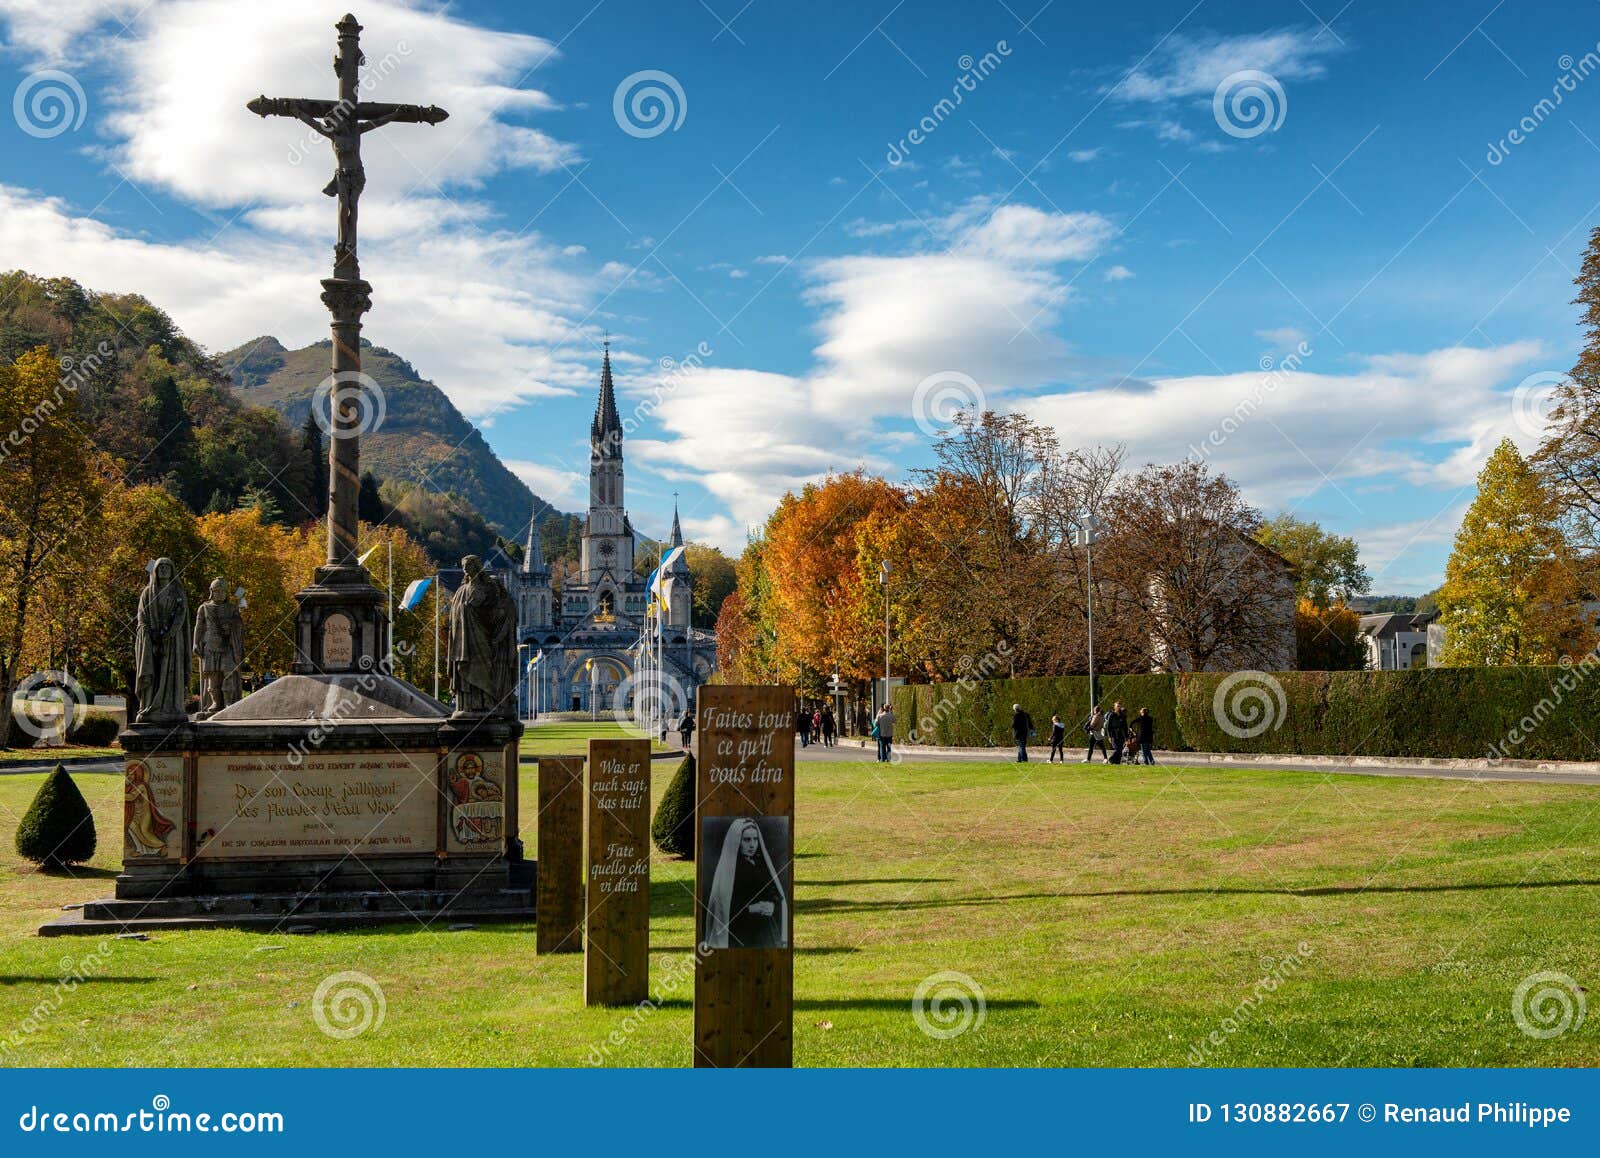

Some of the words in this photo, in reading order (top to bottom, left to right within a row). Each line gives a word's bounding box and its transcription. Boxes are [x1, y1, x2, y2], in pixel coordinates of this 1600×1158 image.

[702, 705, 752, 731] Faites
[758, 708, 793, 729] tout
[717, 738, 733, 756] ce
[738, 731, 772, 764] qu'il
[600, 759, 625, 774] Was
[628, 763, 640, 774] er
[709, 765, 745, 784] vous
[750, 758, 783, 784] dira
[235, 784, 256, 799] De
[264, 786, 287, 798] son
[592, 776, 617, 792] euch
[621, 778, 648, 796] sagt,
[597, 794, 616, 809] das
[620, 796, 641, 809] tut!
[607, 843, 634, 859] Fate
[591, 860, 625, 879] quello
[600, 879, 611, 891] vi
